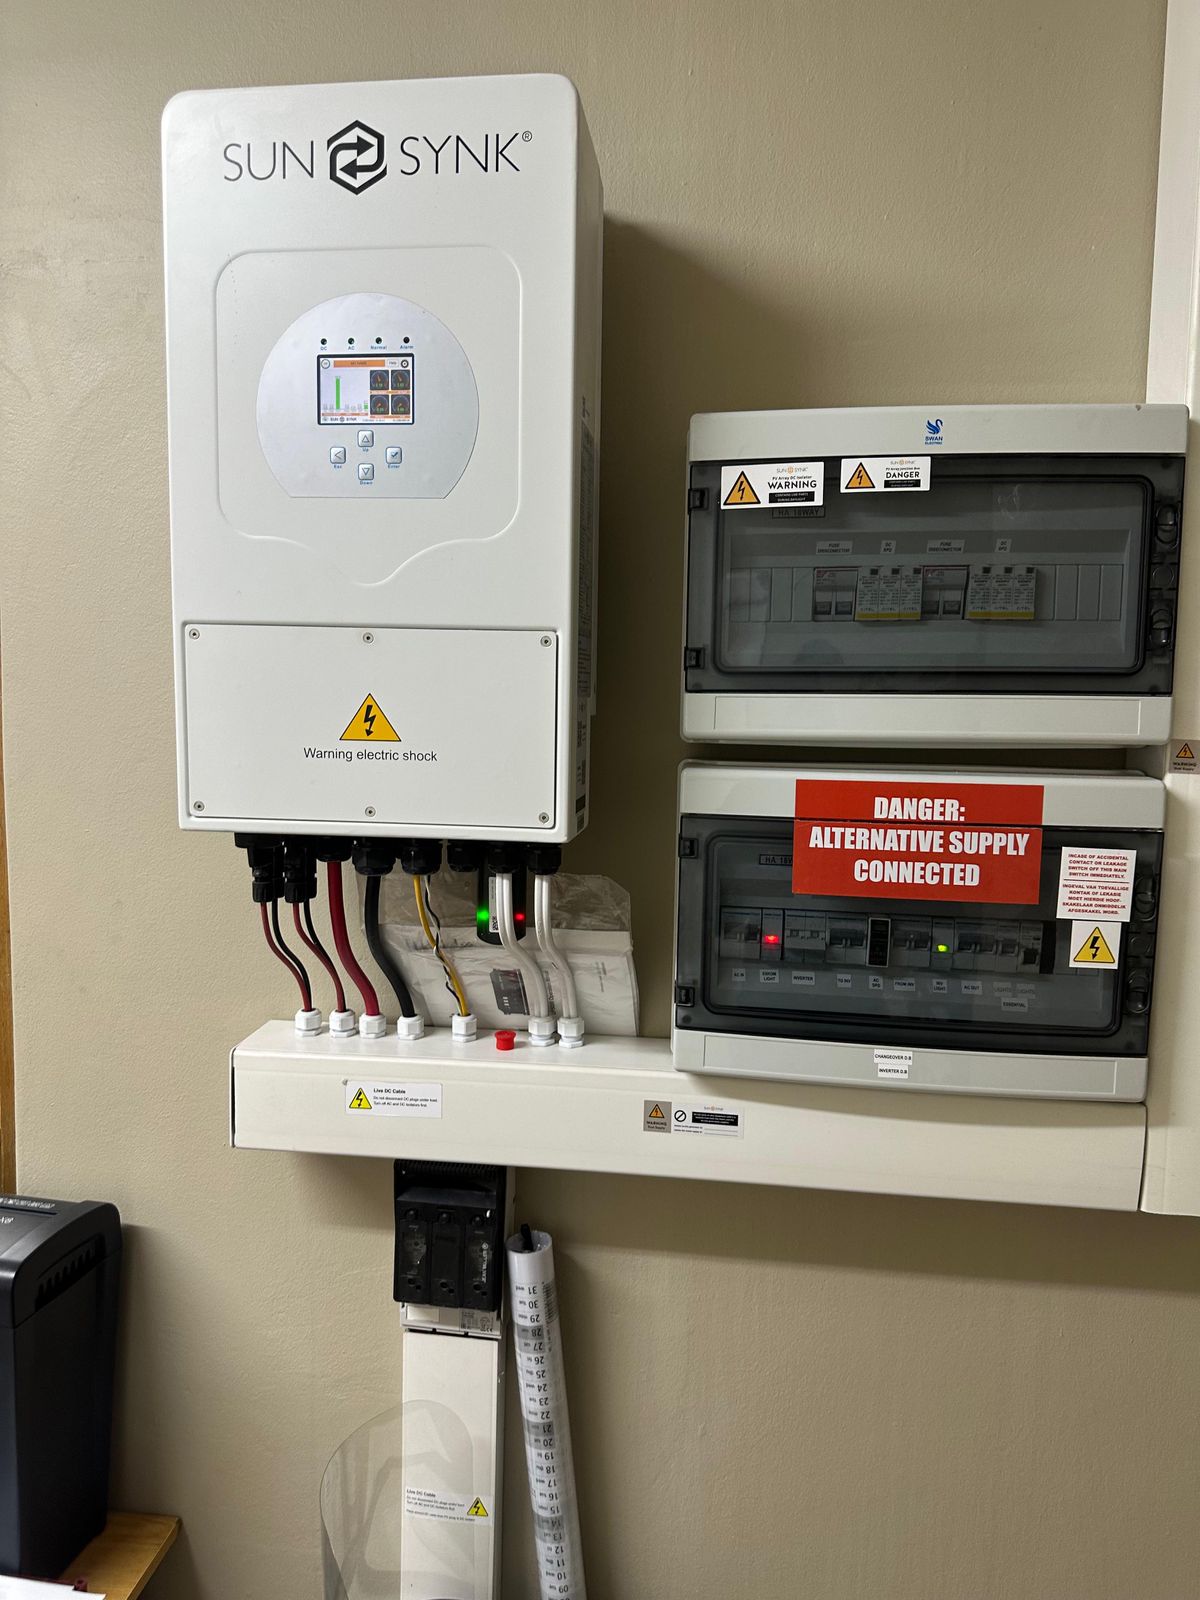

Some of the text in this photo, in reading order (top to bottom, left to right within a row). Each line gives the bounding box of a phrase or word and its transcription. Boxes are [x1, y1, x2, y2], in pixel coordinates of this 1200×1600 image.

[223, 140, 314, 182] SUN
[767, 480, 817, 490] WARNING
[303, 747, 438, 762] Warning electric shock
[873, 796, 966, 822] DANGER:
[808, 825, 1030, 857] ALTERNATIVE SUPPLY
[853, 859, 980, 887] CONNECTED
[528, 1286, 536, 1294] 31
[528, 1300, 538, 1309] 30
[530, 1314, 540, 1323] 29
[531, 1328, 542, 1337] 28
[533, 1342, 543, 1351] 27
[534, 1356, 544, 1364] 26
[536, 1370, 546, 1378] 25
[537, 1384, 548, 1392] 24
[538, 1397, 549, 1406] 23
[540, 1410, 550, 1420] 22
[542, 1424, 552, 1433] 21
[542, 1438, 553, 1447] 20
[544, 1452, 554, 1460] 19
[546, 1465, 556, 1474] 18
[548, 1479, 557, 1488] 17
[548, 1492, 558, 1501] 16
[550, 1506, 560, 1514] 15
[552, 1532, 562, 1541] 13
[554, 1546, 564, 1554] 12
[556, 1558, 565, 1567] 11
[556, 1572, 566, 1580] 10
[558, 1584, 568, 1594] 09
